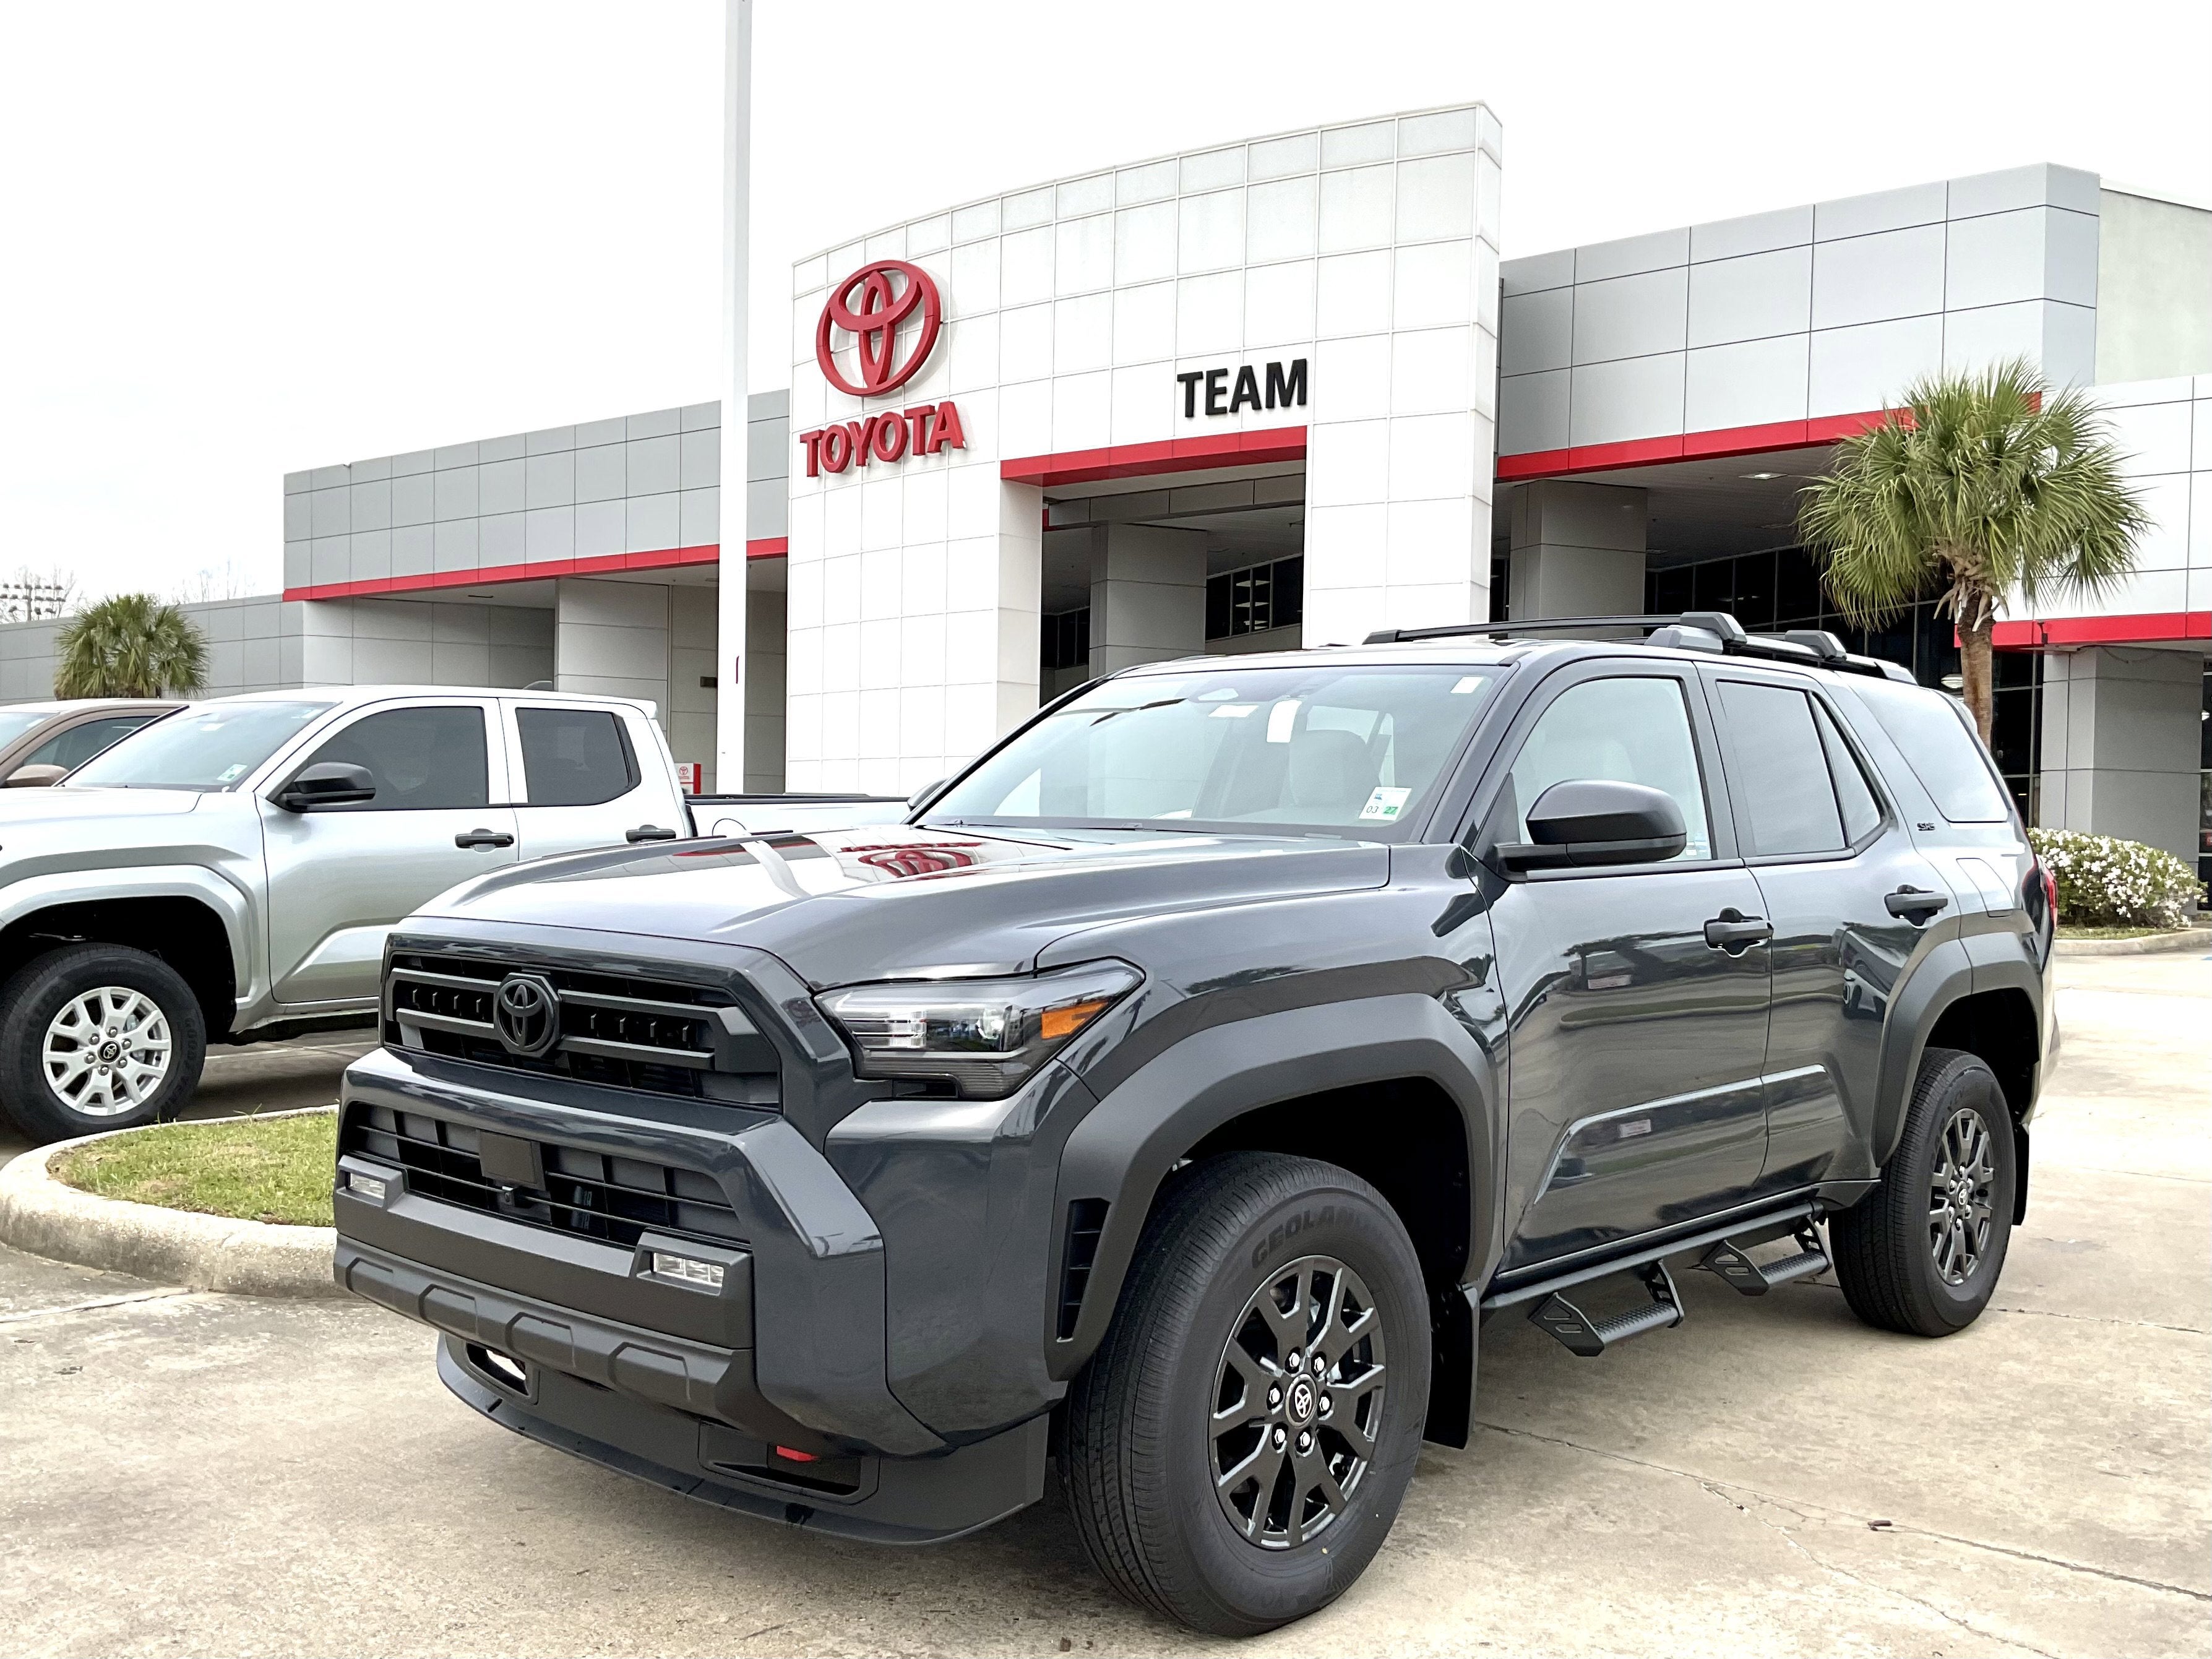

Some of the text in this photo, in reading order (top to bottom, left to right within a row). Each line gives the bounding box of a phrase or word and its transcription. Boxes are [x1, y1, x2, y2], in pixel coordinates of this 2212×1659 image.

[1177, 358, 1307, 418] TEAM
[800, 401, 965, 477] TOYOTA
[1366, 806, 1379, 814] 03
